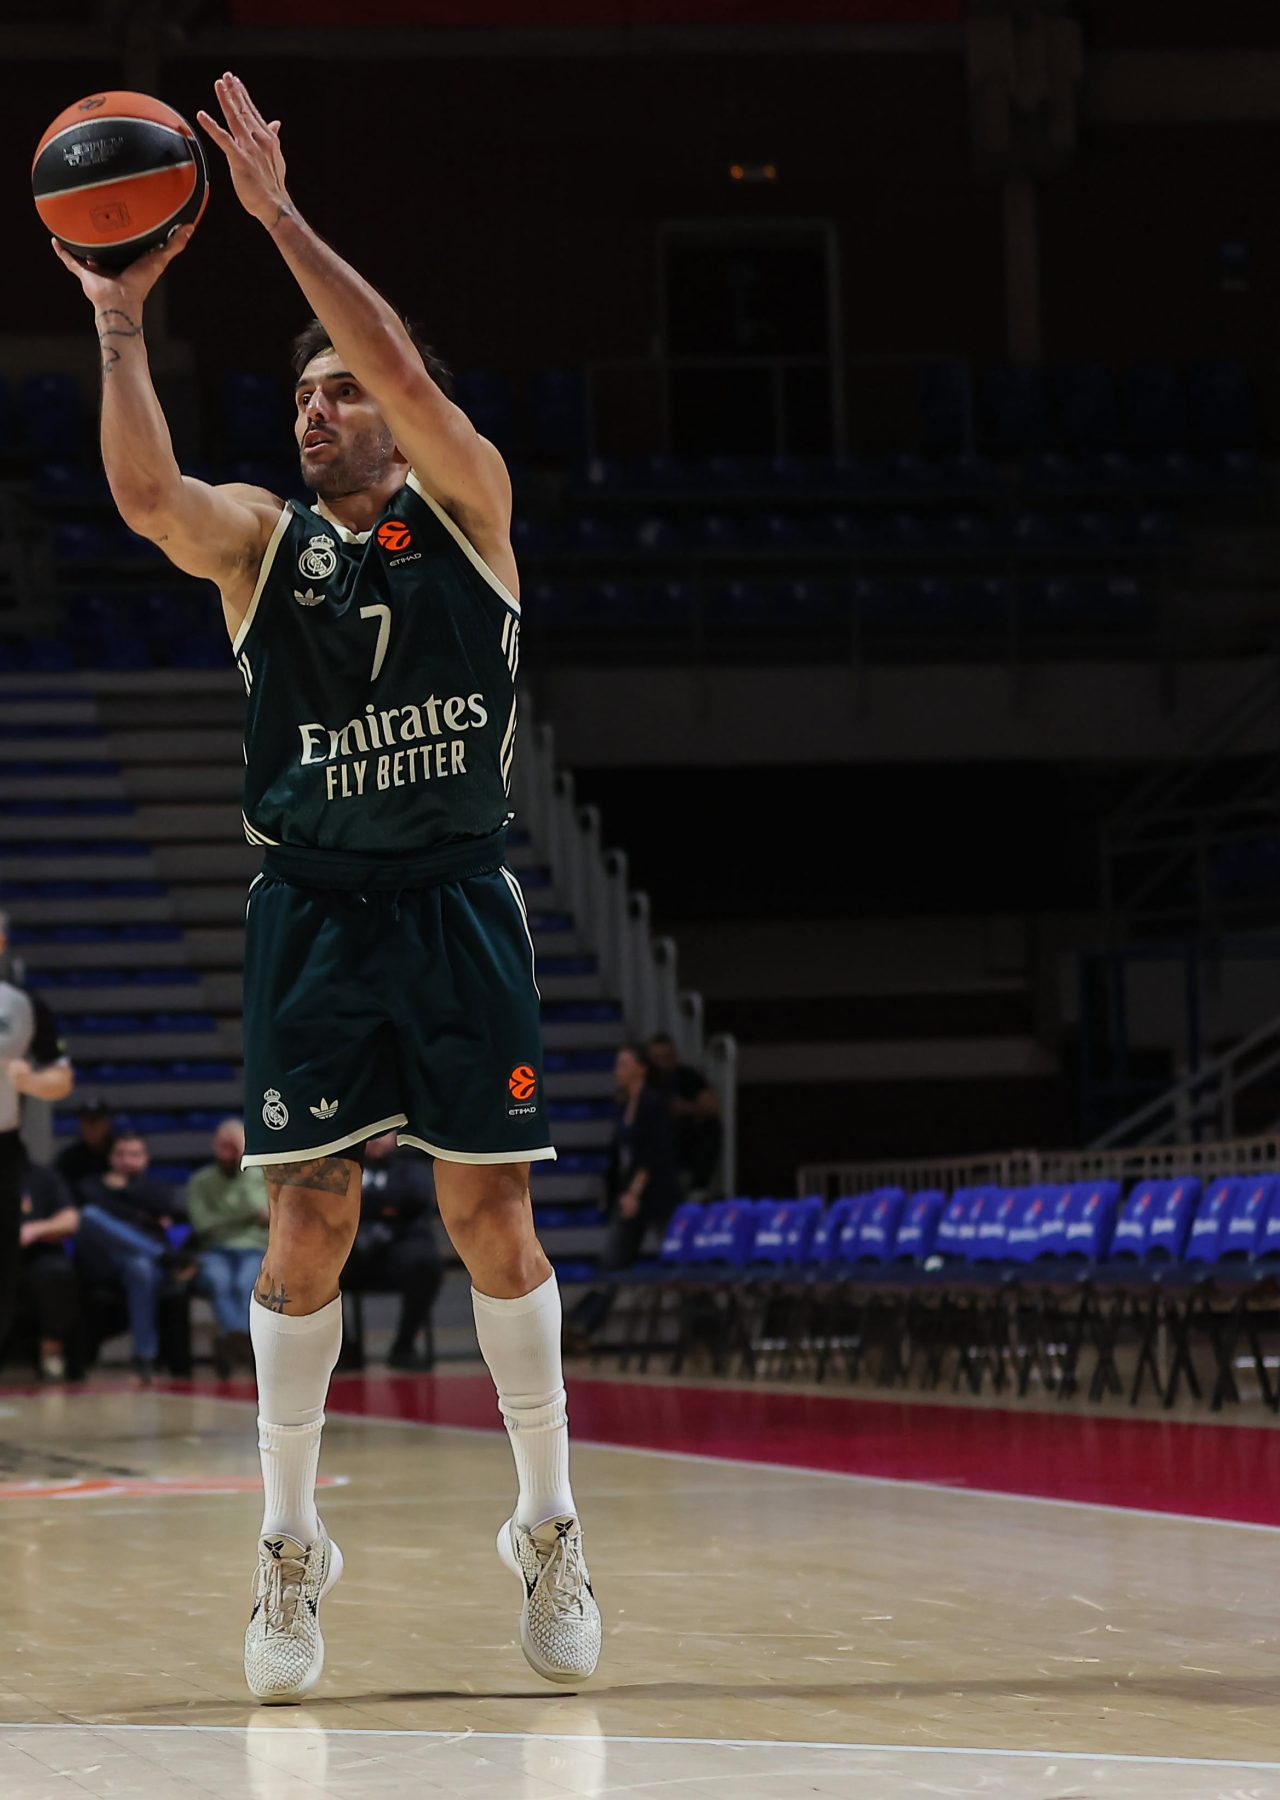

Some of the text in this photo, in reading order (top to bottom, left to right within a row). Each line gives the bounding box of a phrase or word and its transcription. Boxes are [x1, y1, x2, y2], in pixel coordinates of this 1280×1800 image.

[389, 552, 422, 567] ETIHAD
[359, 603, 392, 682] 7
[298, 693, 489, 766] Emirates
[325, 740, 468, 801] FLY BETTER
